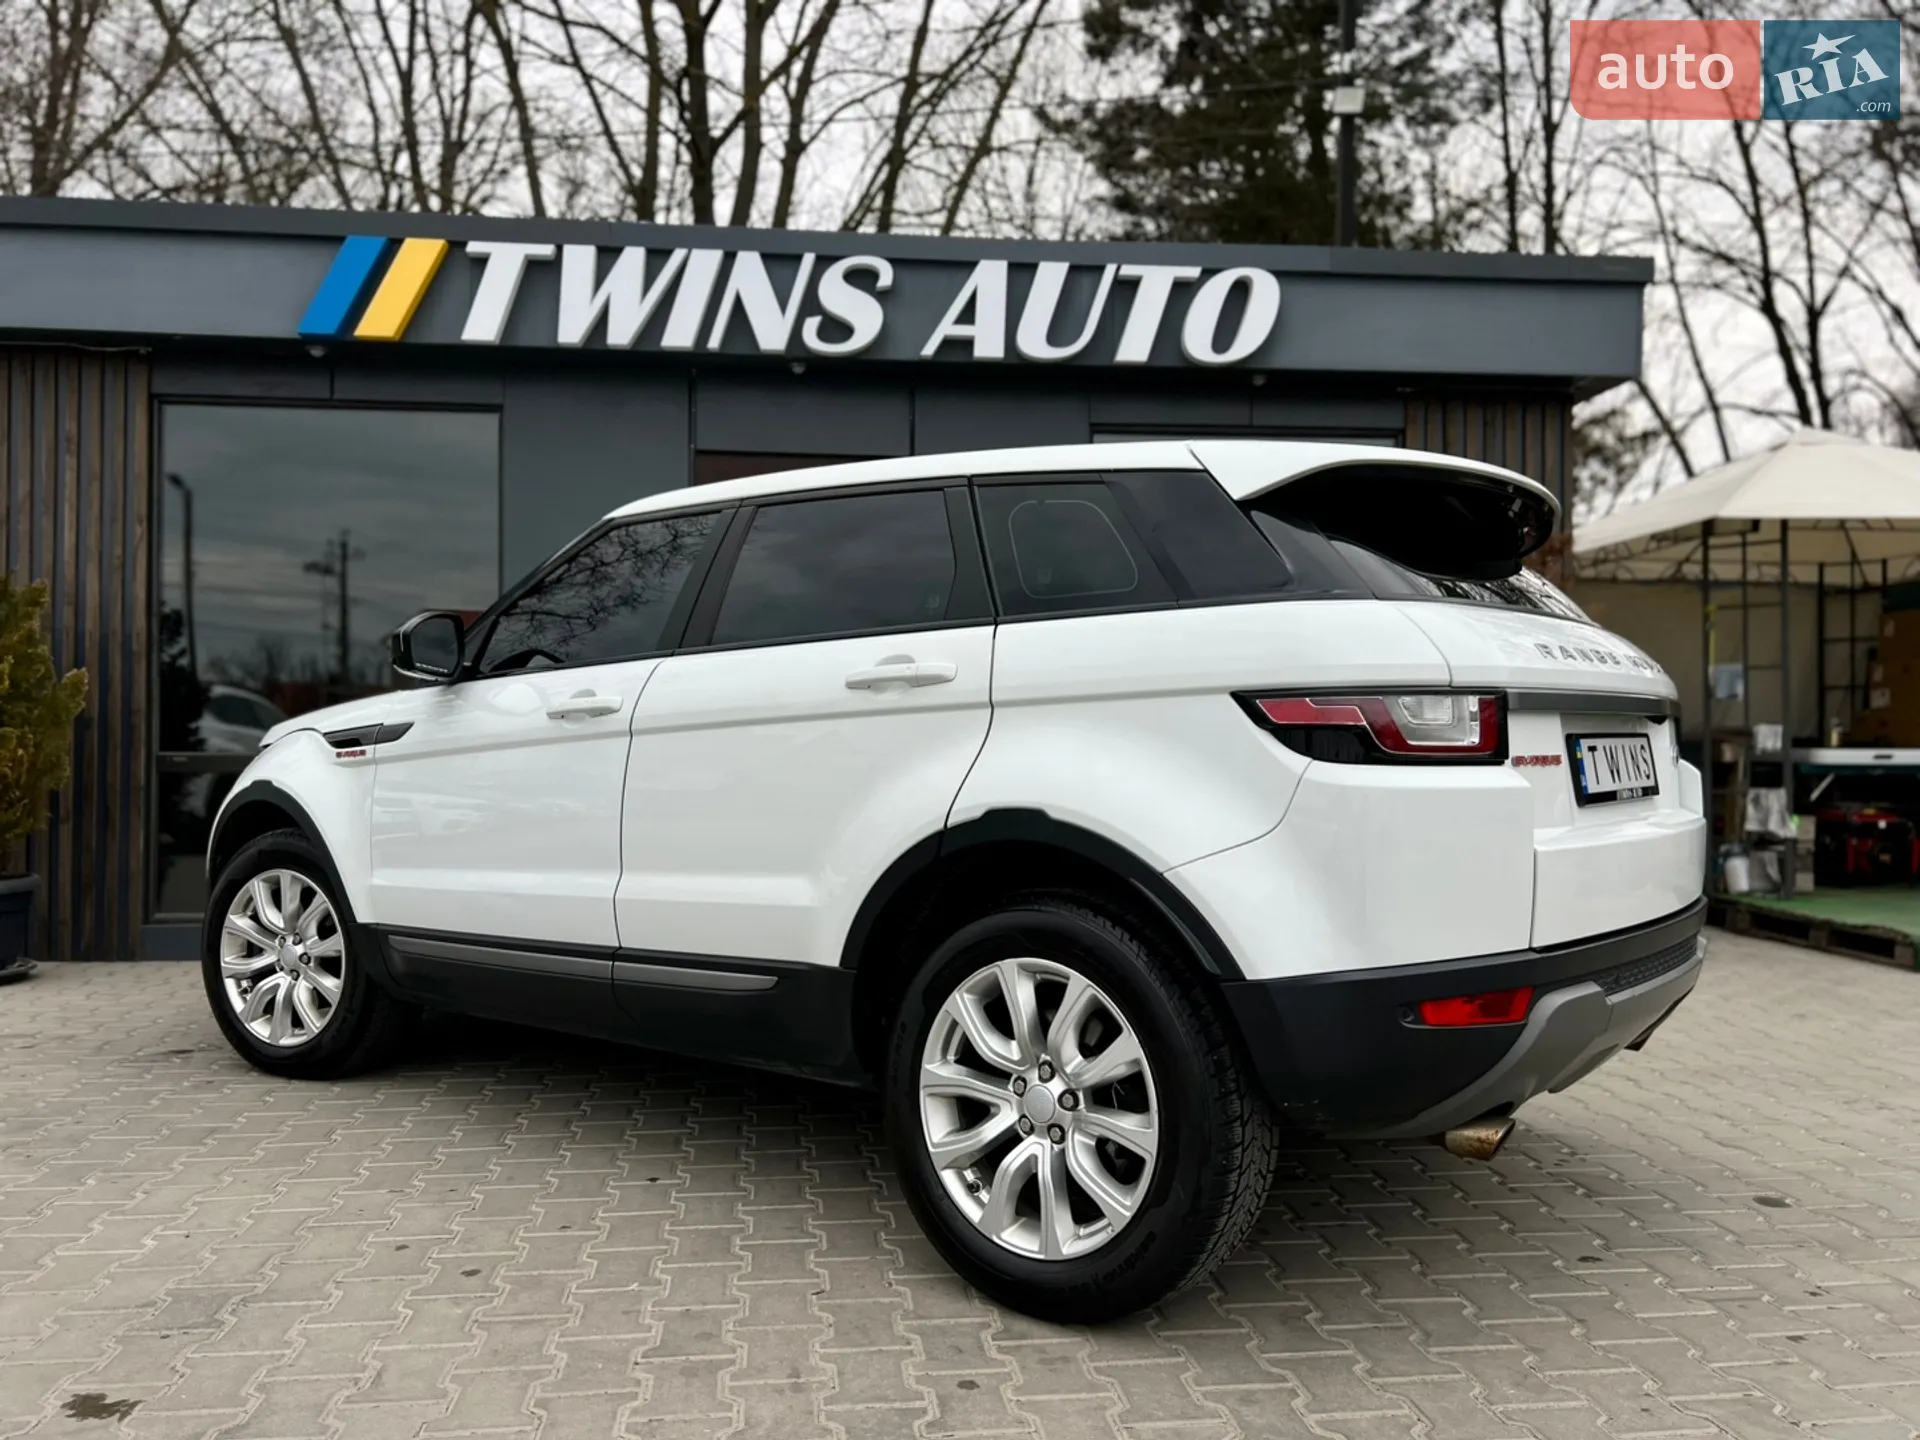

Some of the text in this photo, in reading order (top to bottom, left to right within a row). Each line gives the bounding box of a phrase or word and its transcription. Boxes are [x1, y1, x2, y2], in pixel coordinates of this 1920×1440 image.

[460, 241, 1281, 366] TWINS AUTO
[1534, 643, 1621, 666] RANGE
[1587, 744, 1651, 785] TWINS
